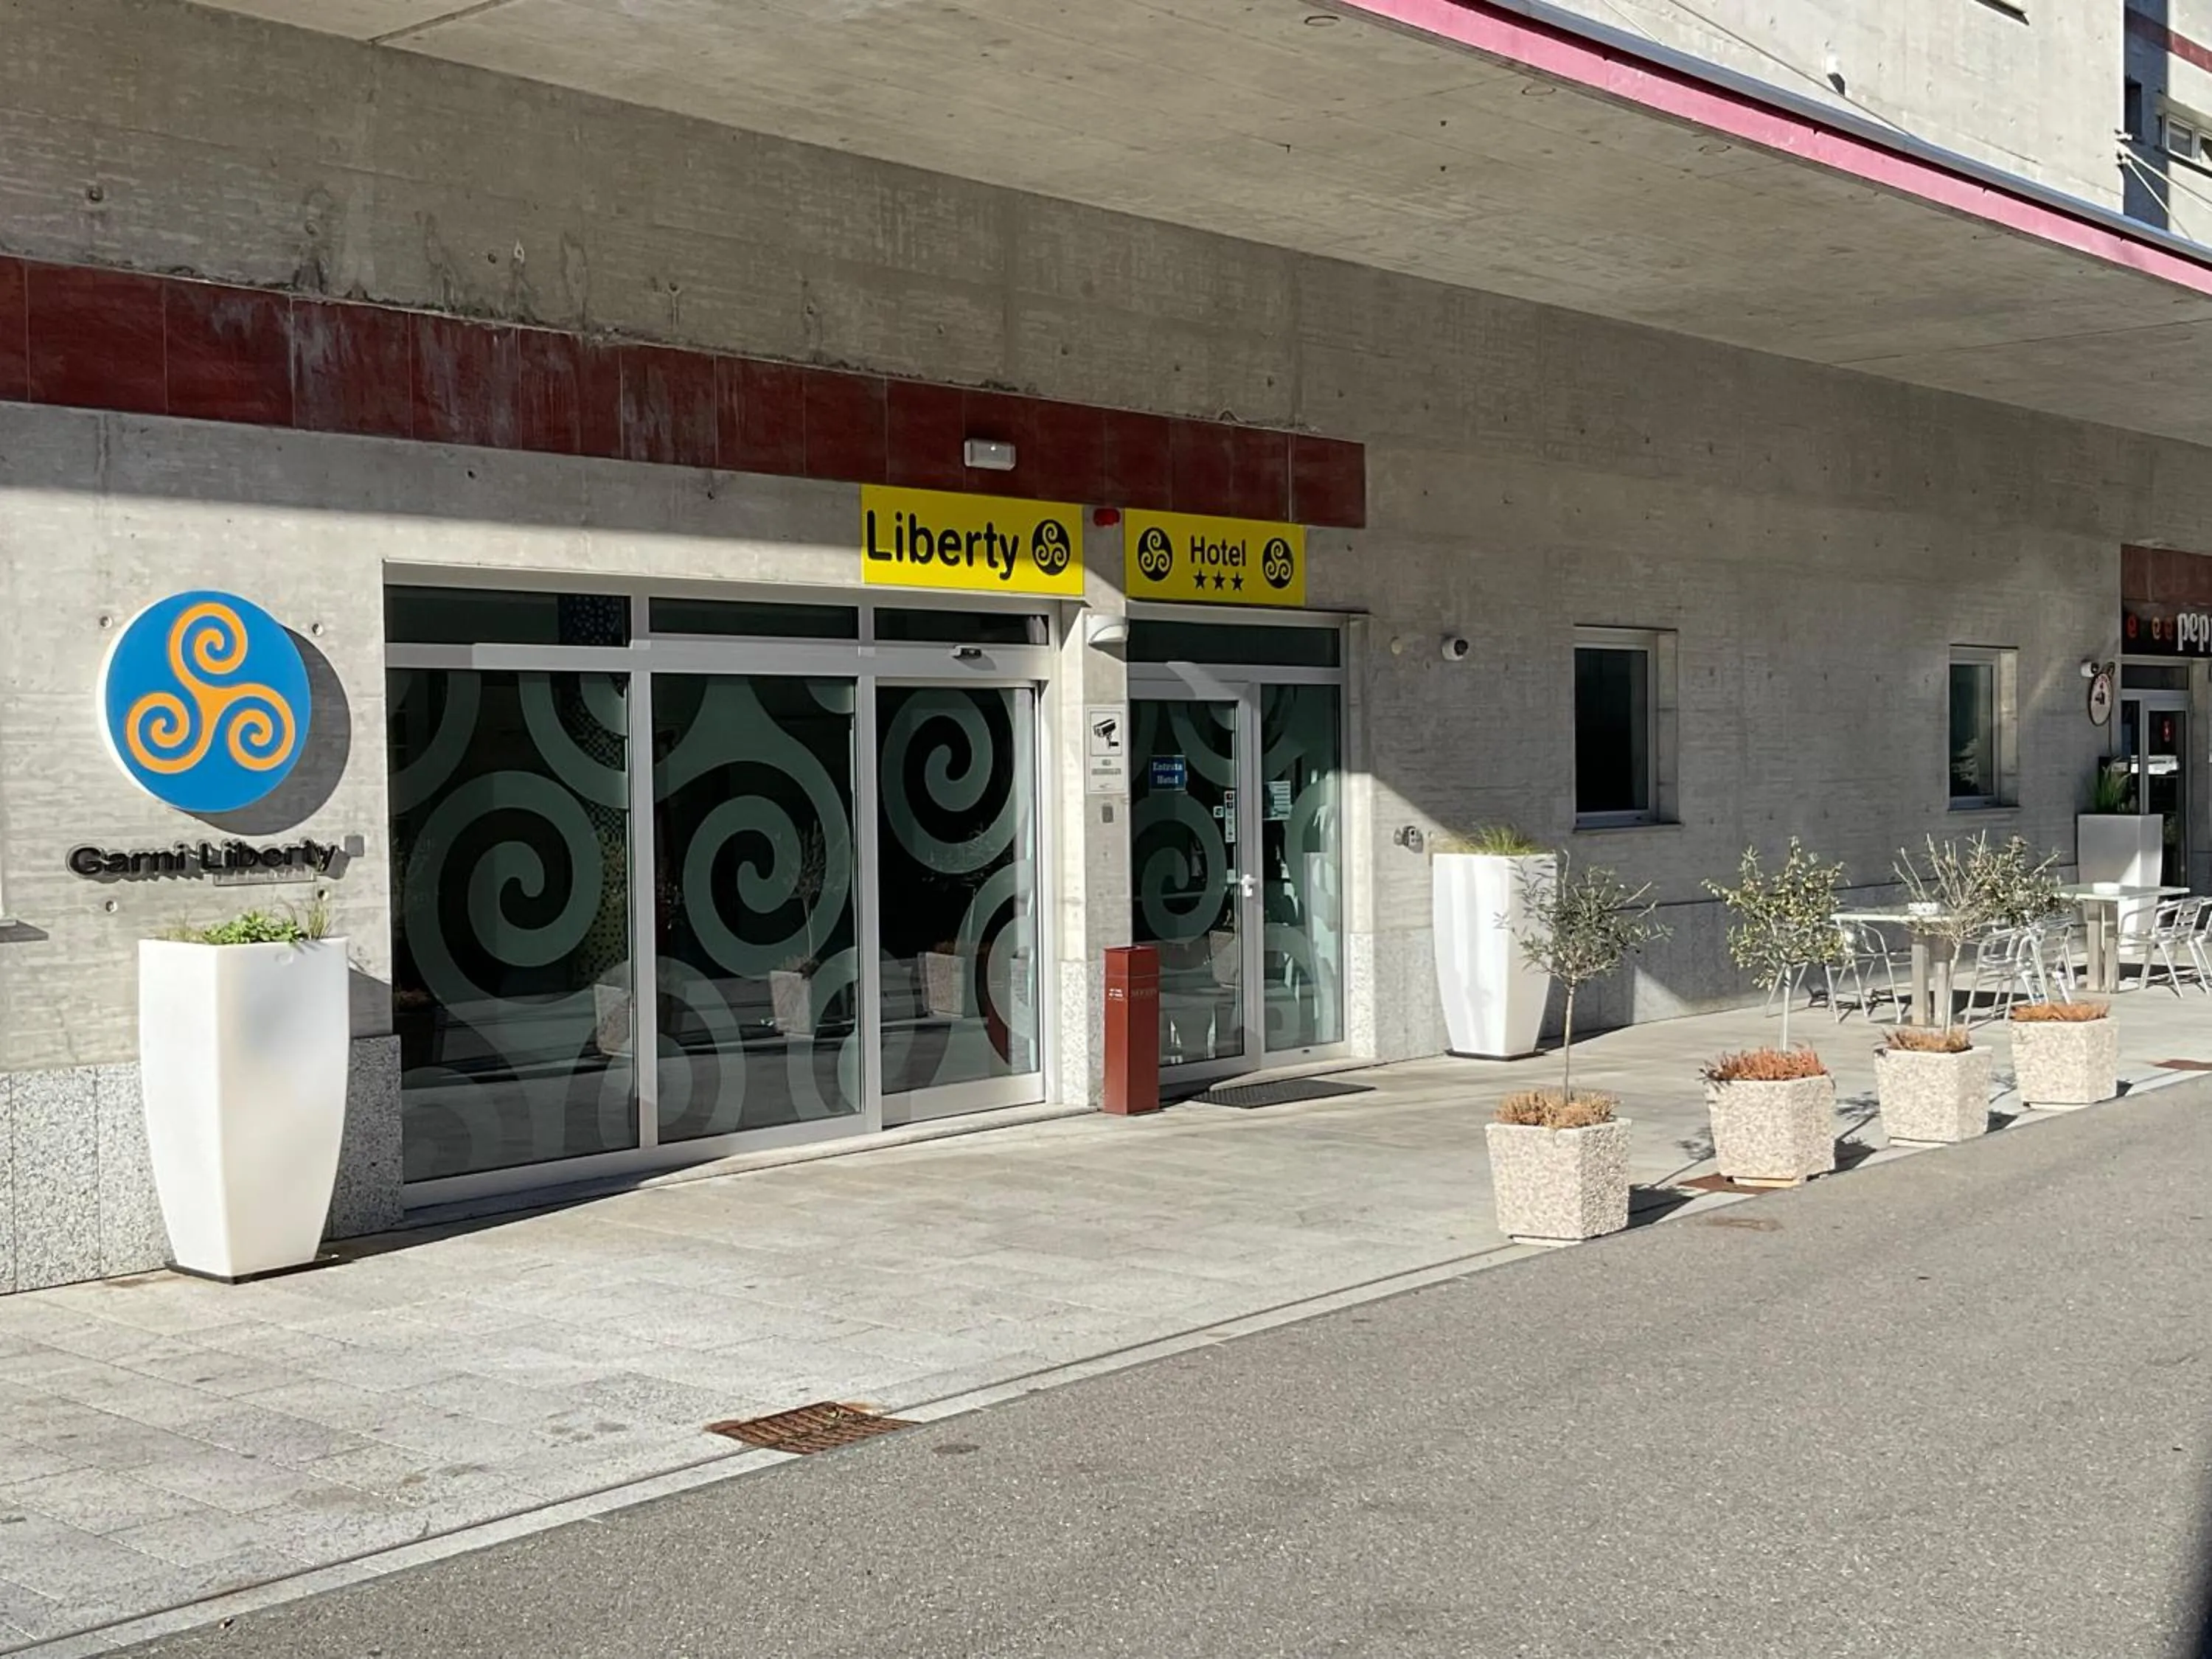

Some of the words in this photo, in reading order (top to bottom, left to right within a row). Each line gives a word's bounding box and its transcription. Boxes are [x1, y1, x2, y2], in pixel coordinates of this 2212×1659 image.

[866, 509, 1020, 580] Liberty
[1190, 535, 1247, 568] Hotel
[2177, 613, 2212, 653] pep
[68, 843, 187, 876] Garni
[198, 838, 338, 874] Liberty
